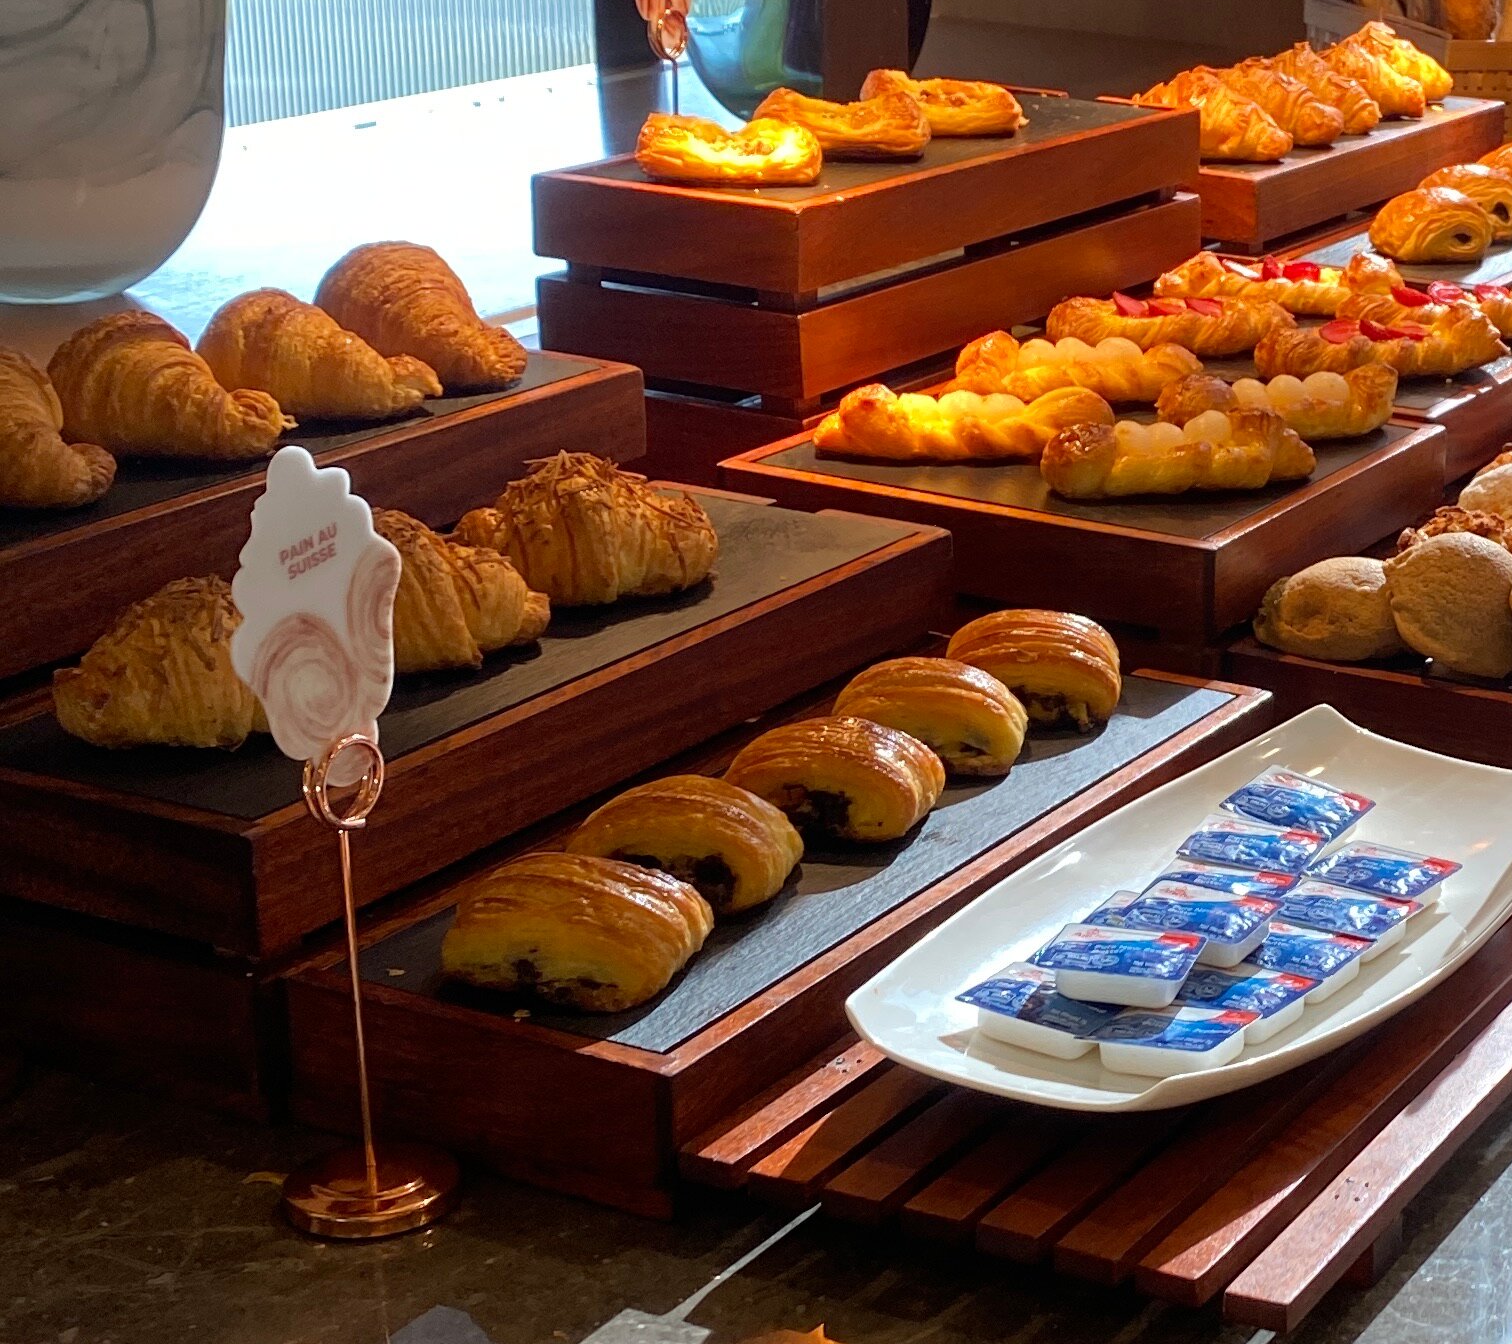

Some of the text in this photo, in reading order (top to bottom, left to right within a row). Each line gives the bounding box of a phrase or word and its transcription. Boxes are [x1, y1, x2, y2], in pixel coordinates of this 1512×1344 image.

[279, 521, 338, 566] PAIN AU
[287, 542, 337, 581] SUISSE
